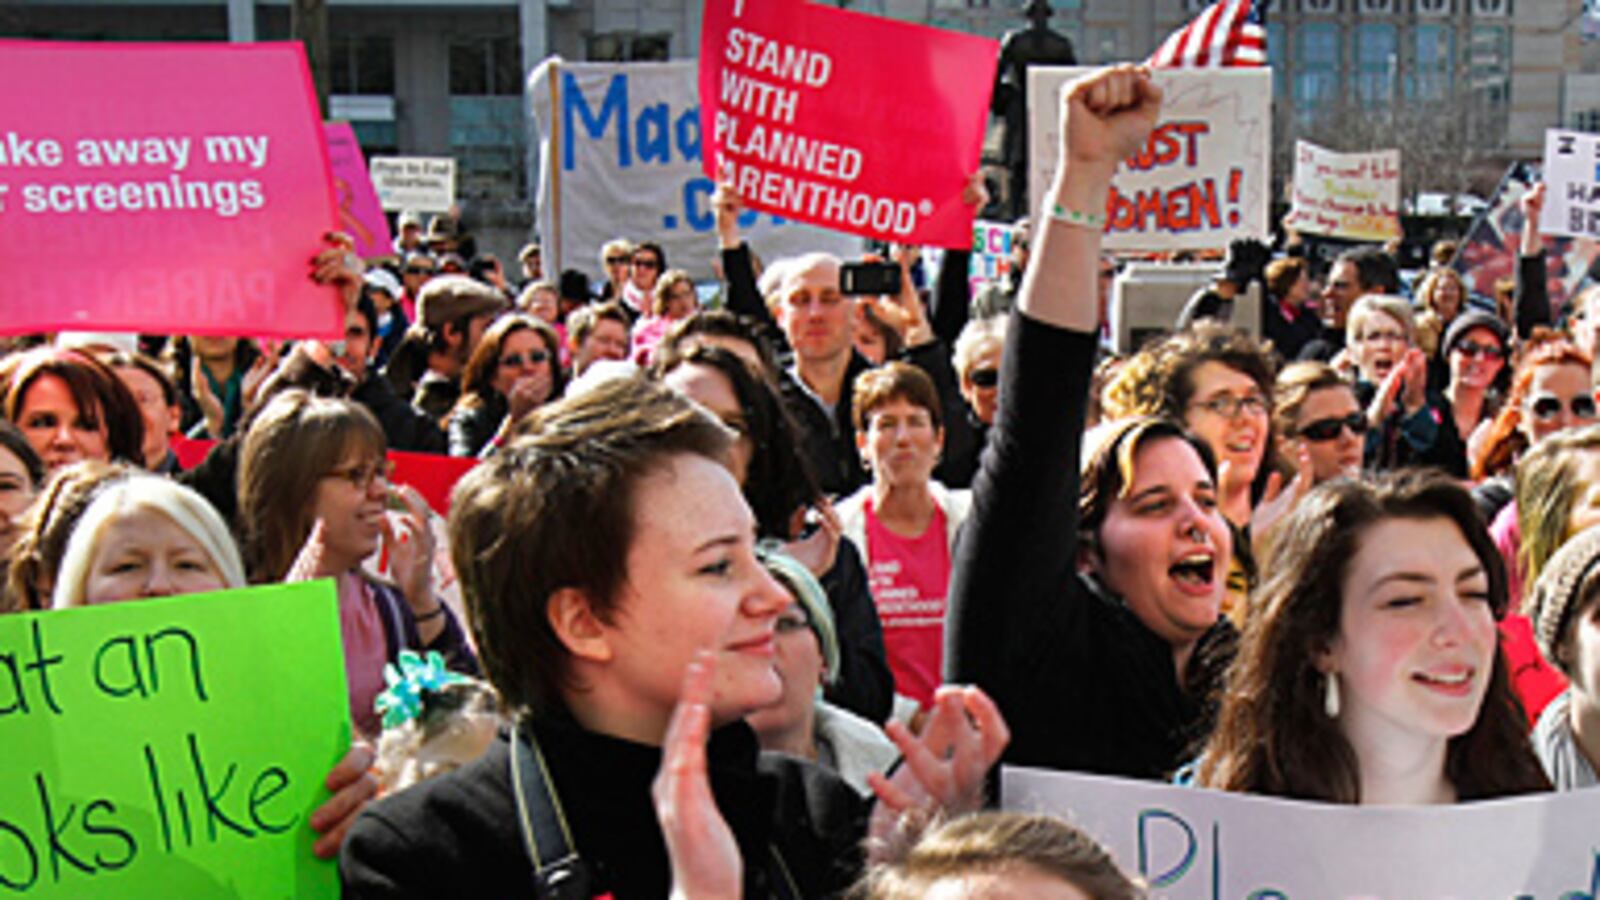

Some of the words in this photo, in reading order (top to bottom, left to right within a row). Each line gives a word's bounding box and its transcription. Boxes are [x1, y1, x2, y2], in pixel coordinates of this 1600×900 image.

[726, 28, 831, 87] STAND
[721, 67, 799, 124] WITH
[77, 137, 190, 170] away
[205, 135, 269, 168] my
[714, 111, 863, 182] PLANNED
[23, 174, 265, 217] screenings
[94, 627, 209, 701] an
[144, 733, 299, 852] like
